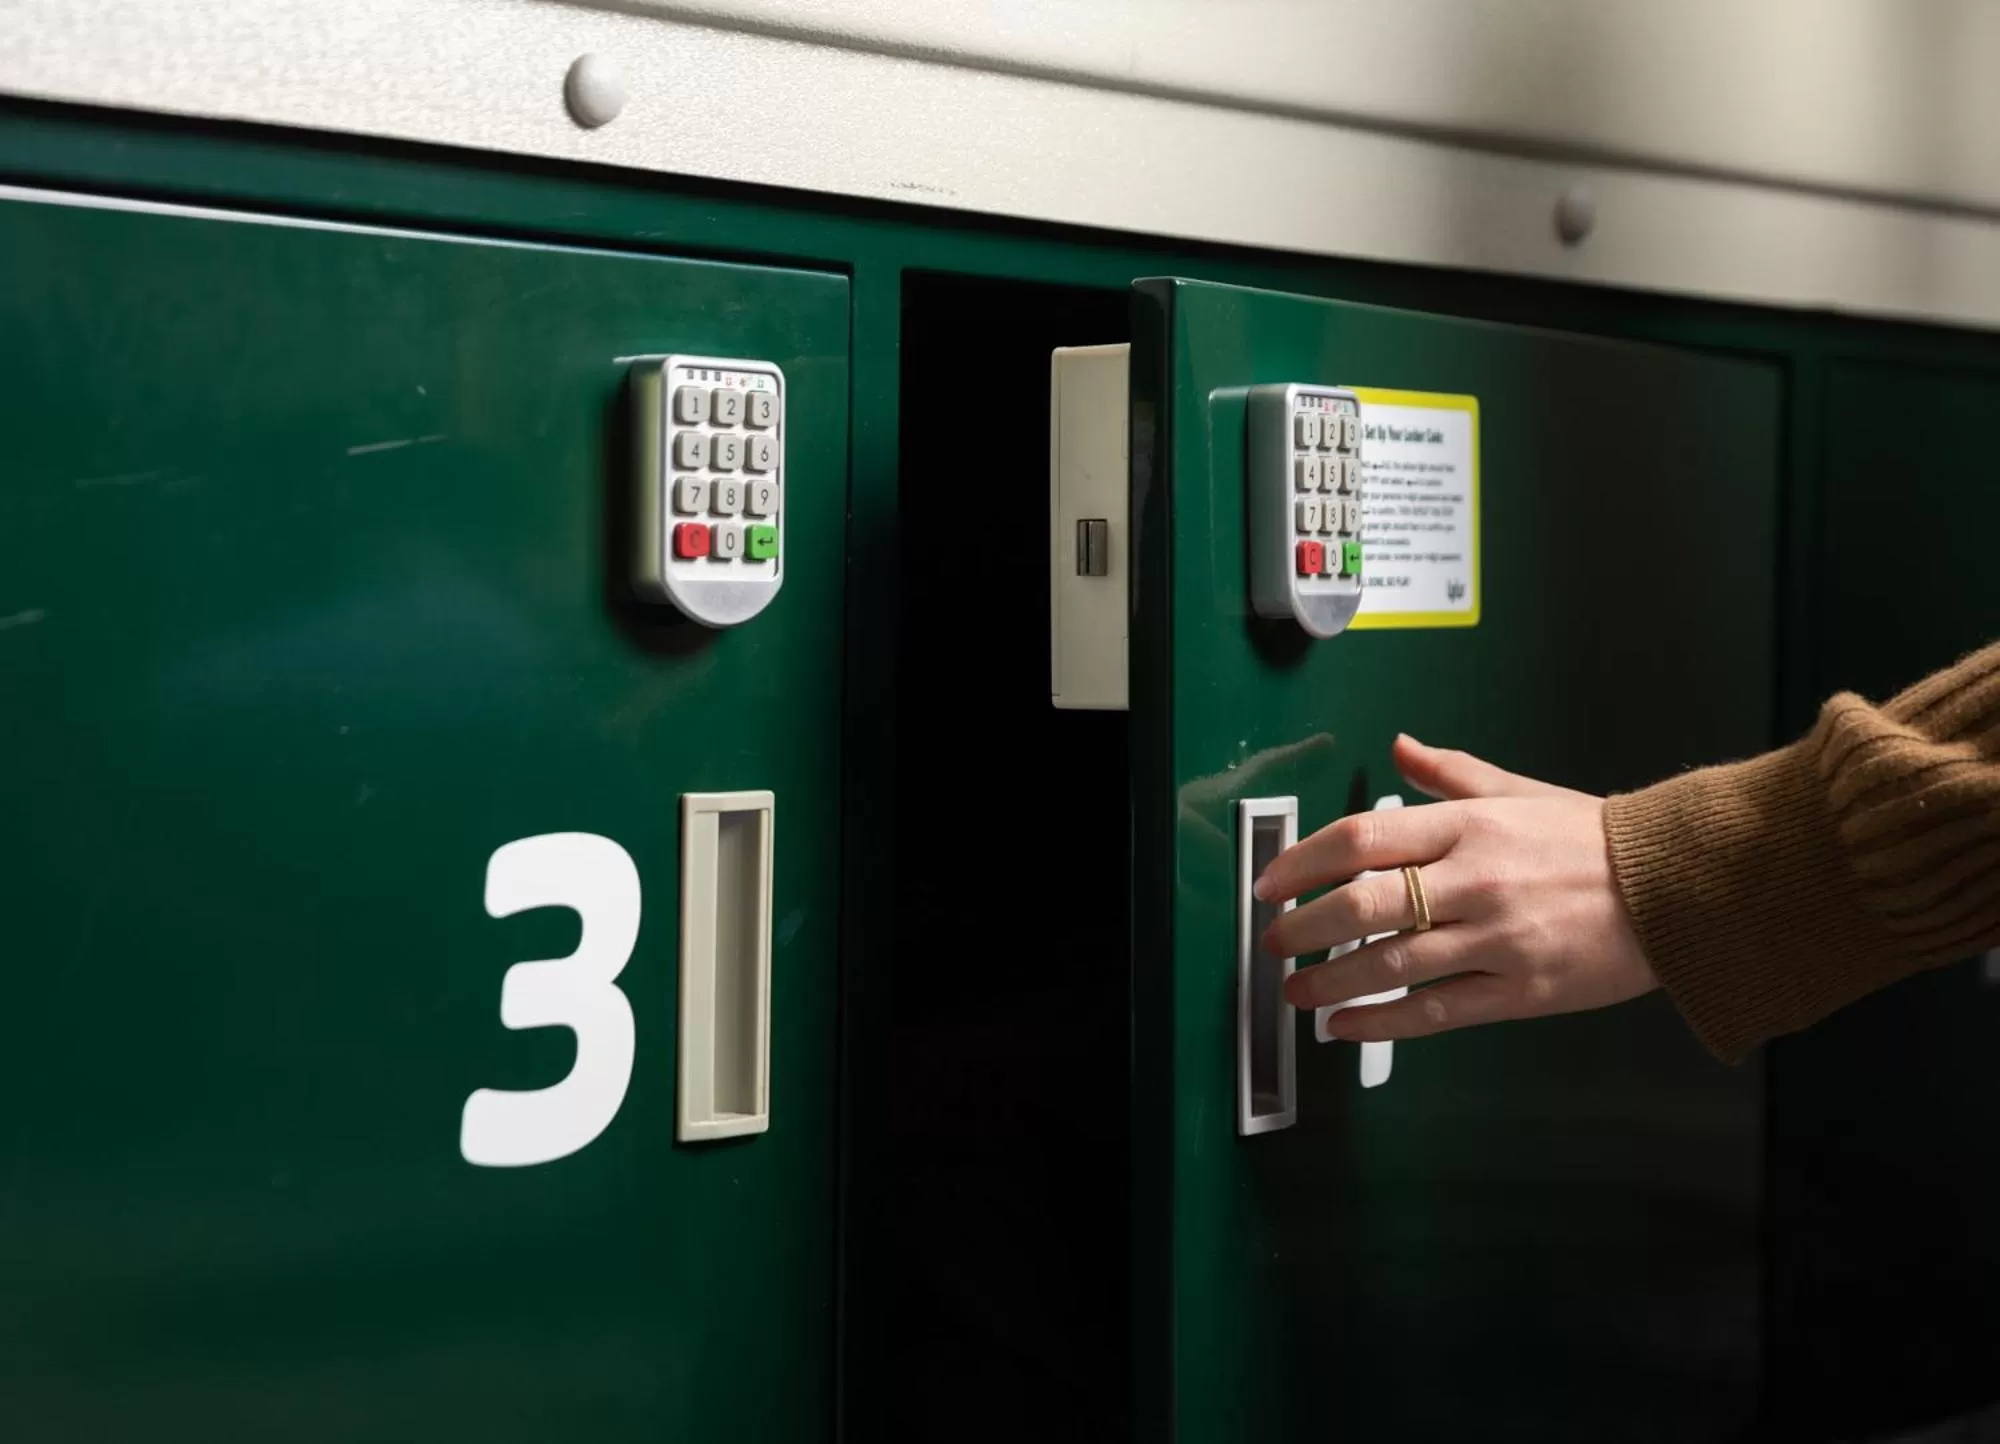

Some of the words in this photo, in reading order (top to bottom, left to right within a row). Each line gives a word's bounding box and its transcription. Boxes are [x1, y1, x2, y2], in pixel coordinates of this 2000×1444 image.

[692, 396, 699, 414] 1
[727, 398, 736, 416] 2
[761, 401, 771, 419] 3
[691, 441, 700, 459] 4
[726, 444, 735, 461] 5
[760, 445, 769, 463] 6
[691, 486, 701, 504] 7
[726, 488, 735, 506] 8
[761, 489, 769, 506] 9
[726, 532, 735, 550] 0
[460, 832, 641, 1166] 3
